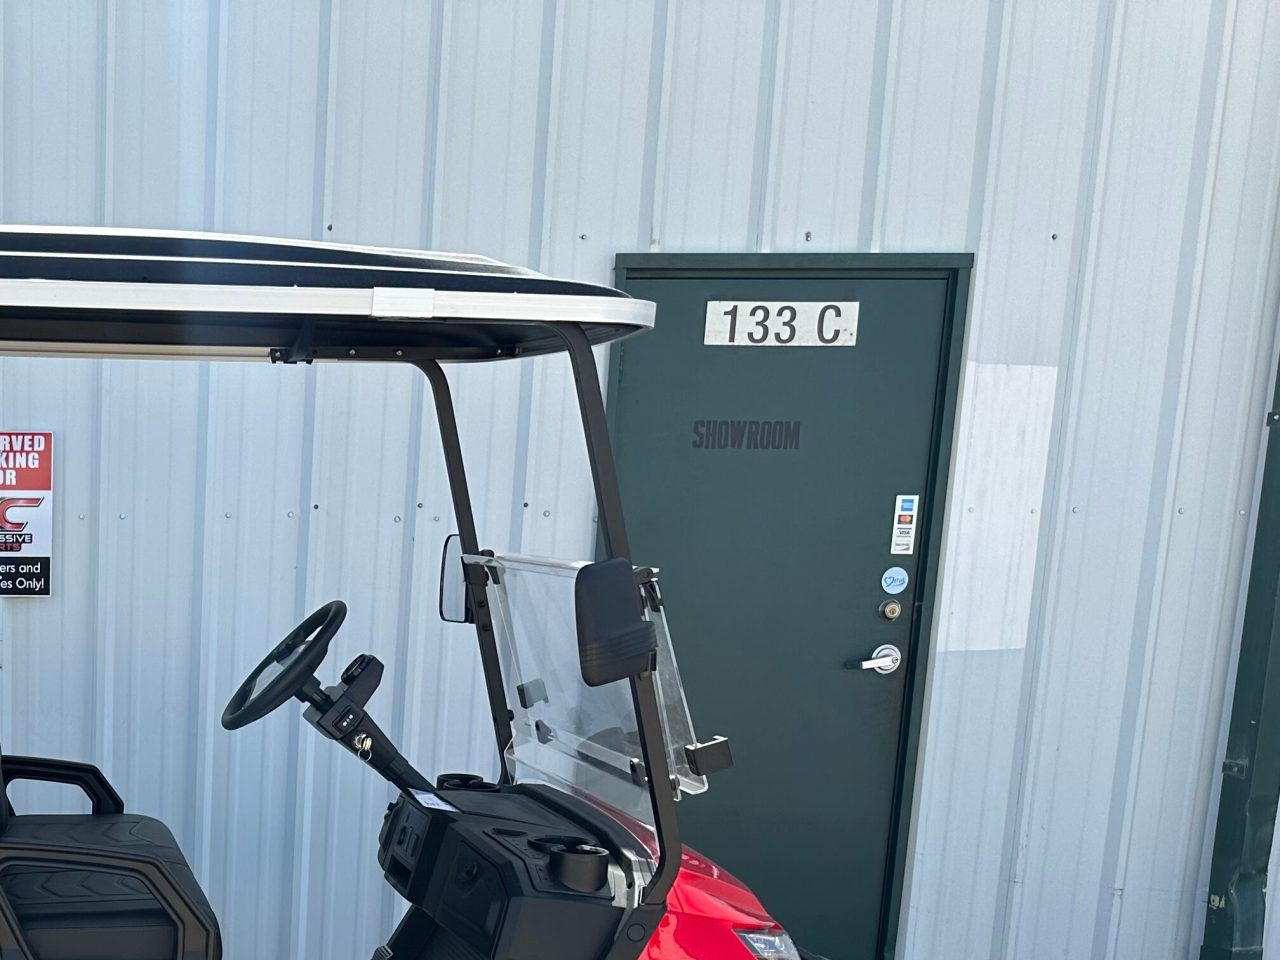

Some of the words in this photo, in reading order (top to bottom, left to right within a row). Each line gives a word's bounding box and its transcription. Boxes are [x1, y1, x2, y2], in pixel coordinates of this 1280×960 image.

[723, 304, 797, 344] 133
[817, 304, 842, 344] C
[692, 420, 801, 450] SHOWROOM
[19, 561, 41, 573] and
[15, 577, 45, 591] Only!
